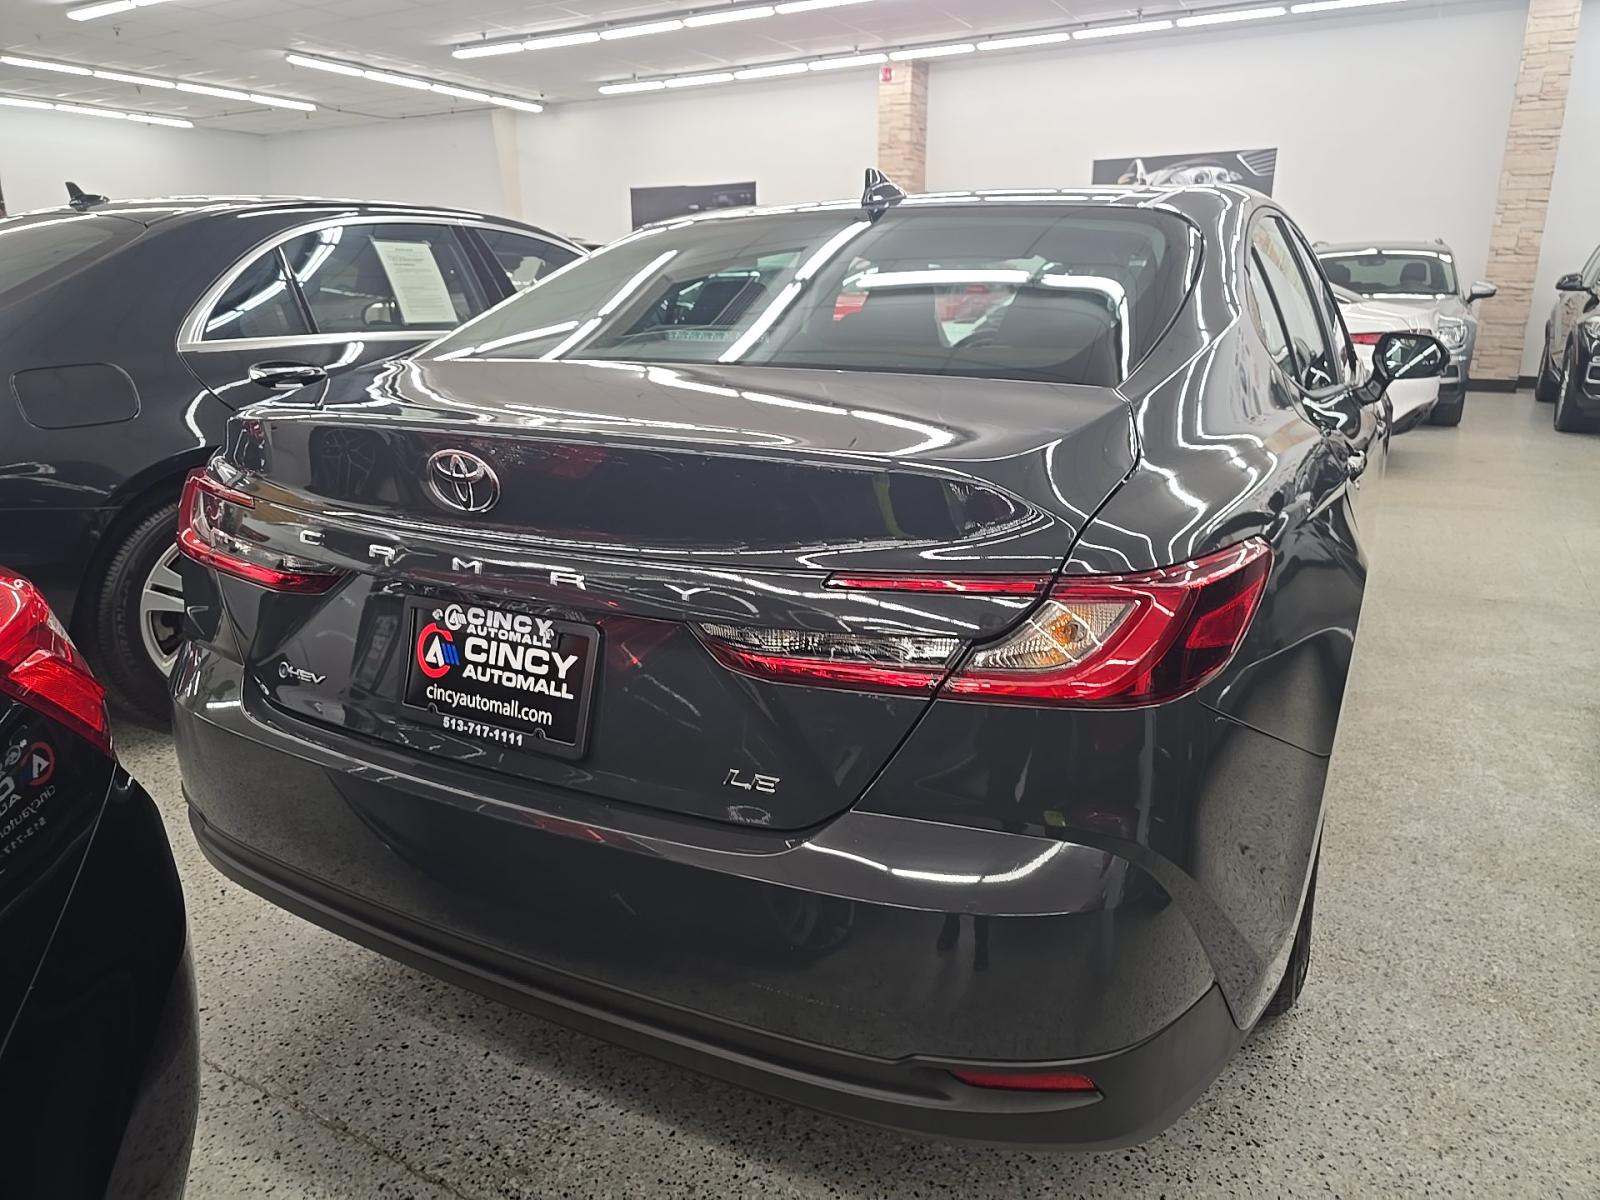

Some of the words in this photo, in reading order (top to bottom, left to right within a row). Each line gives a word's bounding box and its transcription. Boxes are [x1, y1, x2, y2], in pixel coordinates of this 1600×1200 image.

[466, 624, 552, 648] AUTOMALL
[467, 606, 553, 636] CINCY
[464, 636, 579, 680] CINCY
[462, 664, 575, 700] AUTOMALL
[426, 683, 553, 726] cincyautomall.com
[443, 716, 523, 747] 513-717-1111
[722, 767, 781, 793] LE
